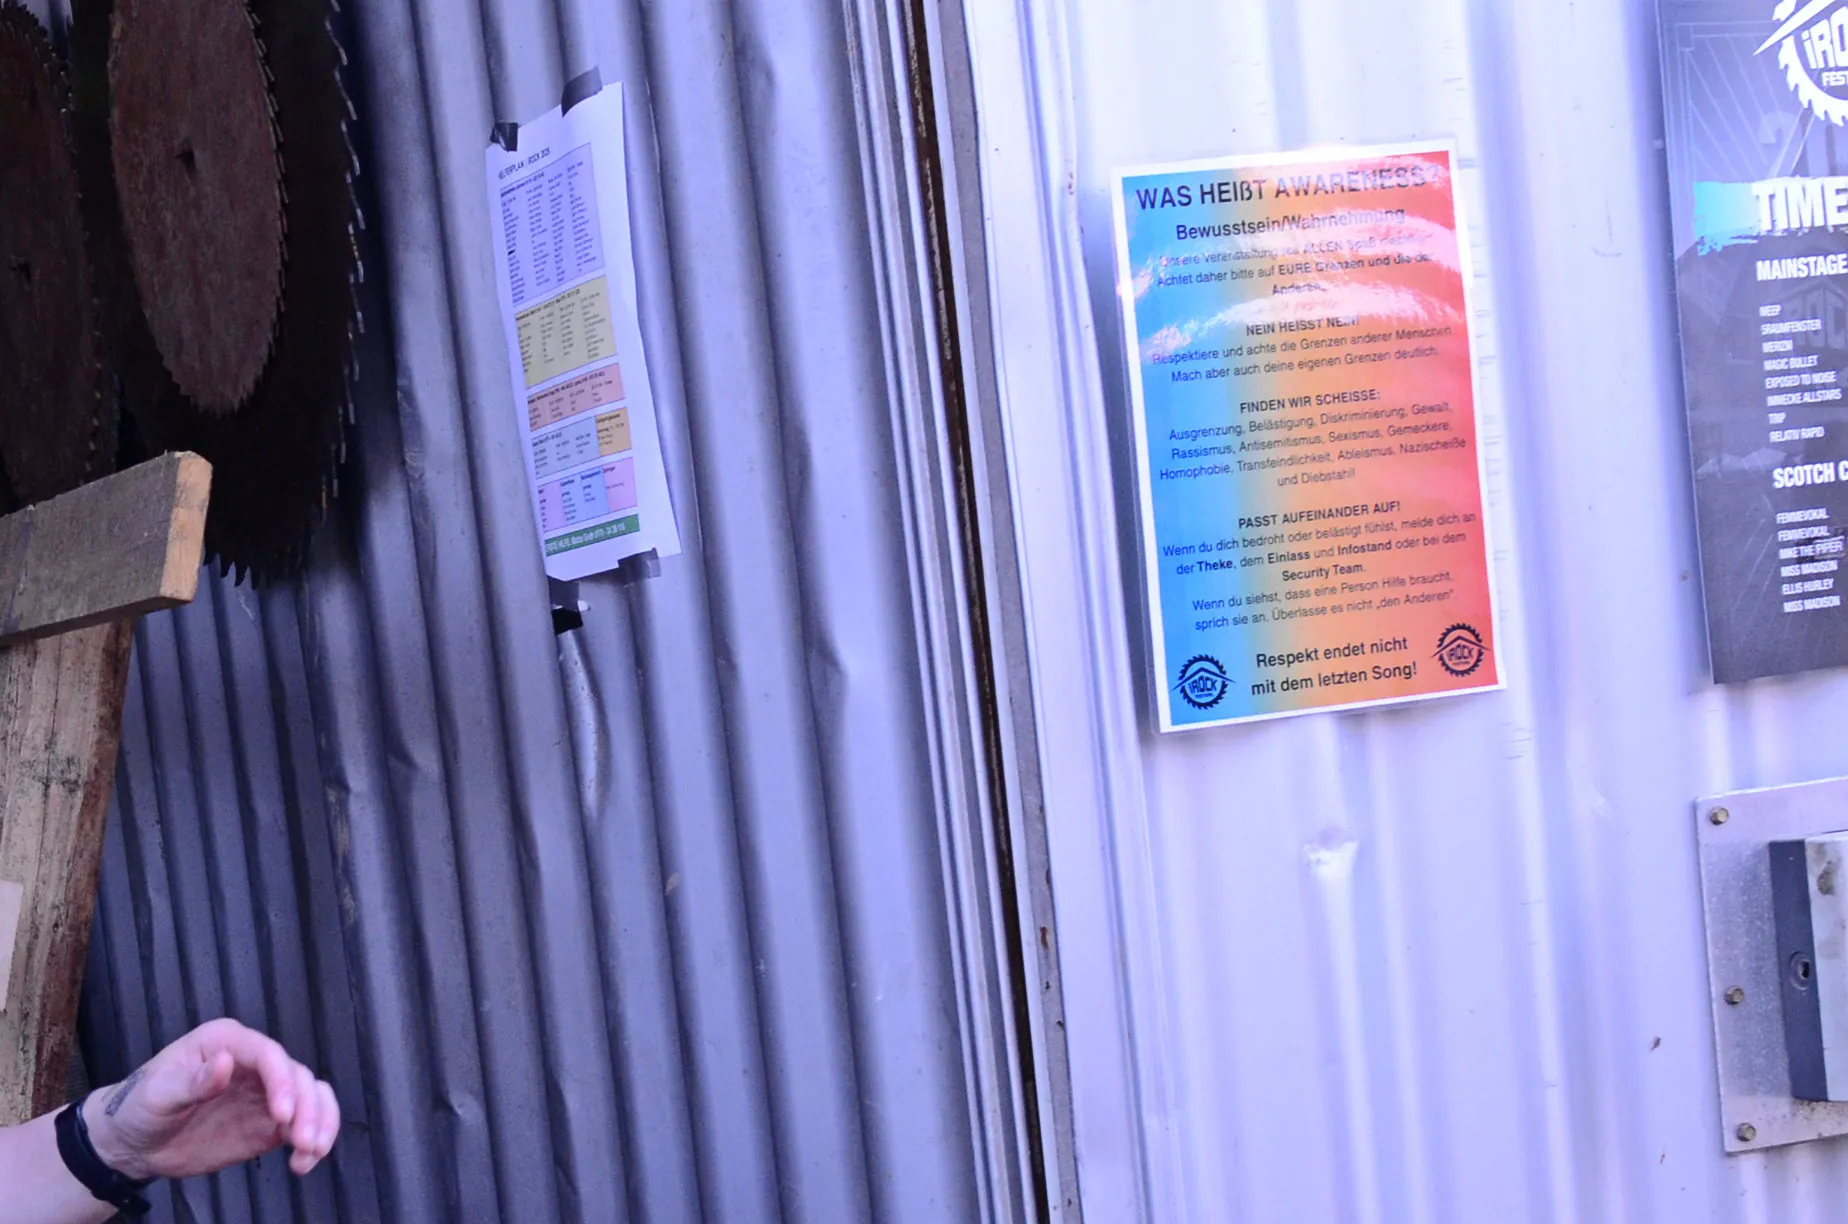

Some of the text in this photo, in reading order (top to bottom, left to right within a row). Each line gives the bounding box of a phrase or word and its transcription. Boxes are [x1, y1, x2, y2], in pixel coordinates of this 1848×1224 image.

[1135, 184, 1192, 210] WAS
[1195, 269, 1227, 282] daher
[1231, 267, 1253, 279] bitte
[1256, 265, 1275, 277] auf
[1278, 262, 1310, 275] EURE
[1367, 255, 1389, 267] und
[1756, 252, 1847, 281] MAINSTAGE
[1245, 322, 1274, 335] NEIN
[1278, 318, 1321, 332] HEISST
[1152, 348, 1218, 366] Respektiere
[1222, 346, 1242, 357] und
[1246, 343, 1276, 355] achte
[1280, 341, 1296, 351] die
[1300, 336, 1347, 350] Grenzen
[1350, 332, 1392, 345] anderer
[1171, 369, 1201, 382] Mach
[1205, 366, 1230, 379] aber
[1234, 363, 1260, 376] auch
[1263, 360, 1294, 373] deine
[1298, 356, 1341, 372] eigenen
[1344, 351, 1390, 365] Grenzen
[1239, 389, 1380, 412] FINDEN WIR SCHEISSE:
[1169, 422, 1245, 442] Ausgrenzung,
[1248, 415, 1316, 434] Belästigung,
[1171, 443, 1235, 460] Rassismus,
[1239, 433, 1324, 453] Antisemitismus,
[1159, 462, 1233, 482] Homophobie,
[1277, 474, 1297, 486] und
[1772, 462, 1835, 488] SCOTCH
[1238, 500, 1400, 528] PASST AUFEINANDER AUF!
[1162, 542, 1195, 556] Wenn
[1198, 541, 1212, 552] du
[1216, 538, 1239, 550] dich
[1242, 533, 1284, 547] bedroht
[1287, 530, 1311, 542] oder
[1315, 524, 1361, 542] belästigt
[1400, 516, 1433, 530] melde
[1437, 513, 1459, 526] dich
[1463, 514, 1475, 523] an
[1176, 532, 1465, 574] der Theke, dem Einlass und Infostand oder bei dem
[1282, 562, 1366, 584] Security Team.
[1192, 597, 1224, 611] Wenn
[1228, 595, 1242, 607] du
[1246, 591, 1281, 606] siehst,
[1284, 588, 1310, 600] dass
[1314, 584, 1337, 597] eine
[1340, 580, 1378, 594] Person
[1194, 616, 1228, 632] sprich
[1231, 614, 1248, 625] sie
[1252, 614, 1268, 623] an.
[1271, 603, 1327, 621] Überlasse
[1331, 605, 1343, 613] es
[1346, 599, 1372, 611] nicht
[1256, 636, 1407, 670] Respekt endet nicht
[1251, 661, 1417, 694] mit dem letzten Song!
